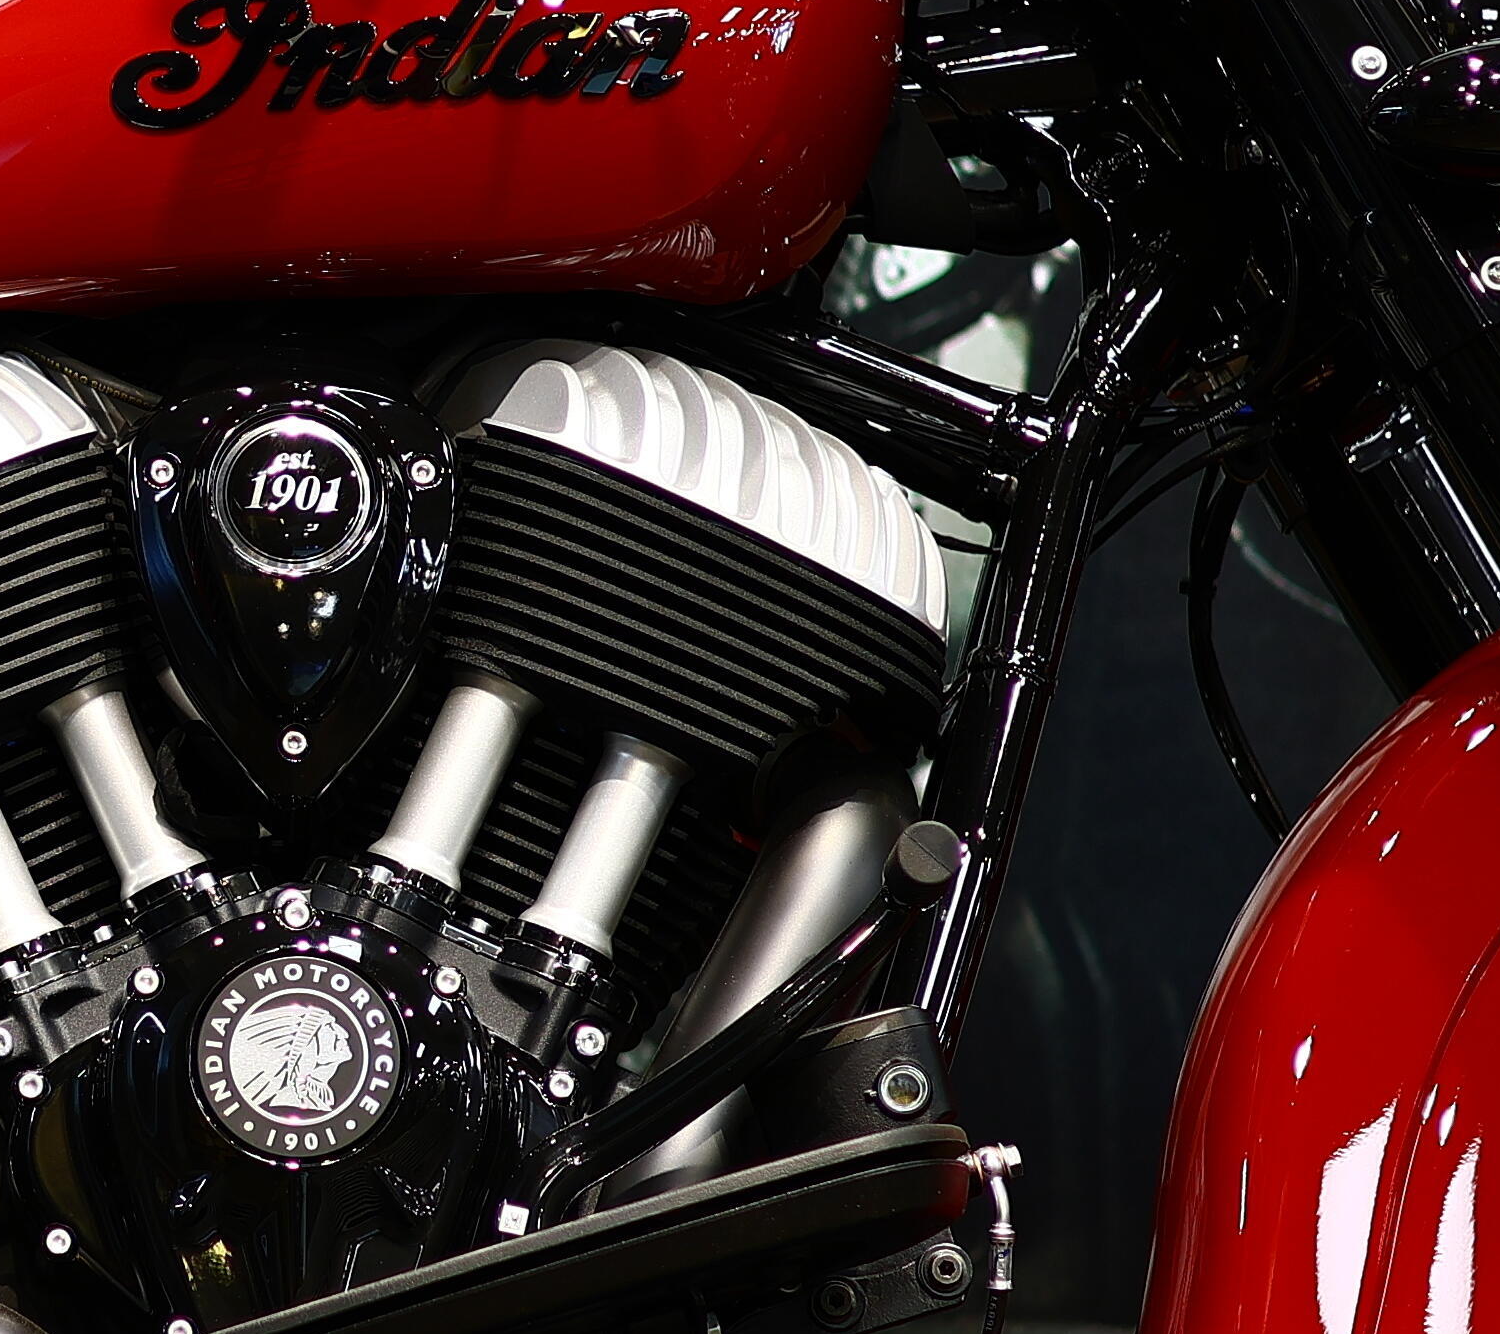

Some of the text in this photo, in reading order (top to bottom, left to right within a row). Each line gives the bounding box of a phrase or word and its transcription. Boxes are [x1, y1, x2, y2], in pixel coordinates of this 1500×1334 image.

[274, 449, 317, 470] est.
[244, 473, 343, 514] 1901
[204, 962, 394, 1117] INDIAN MOTORCYCLE
[265, 1127, 337, 1151] 1901
